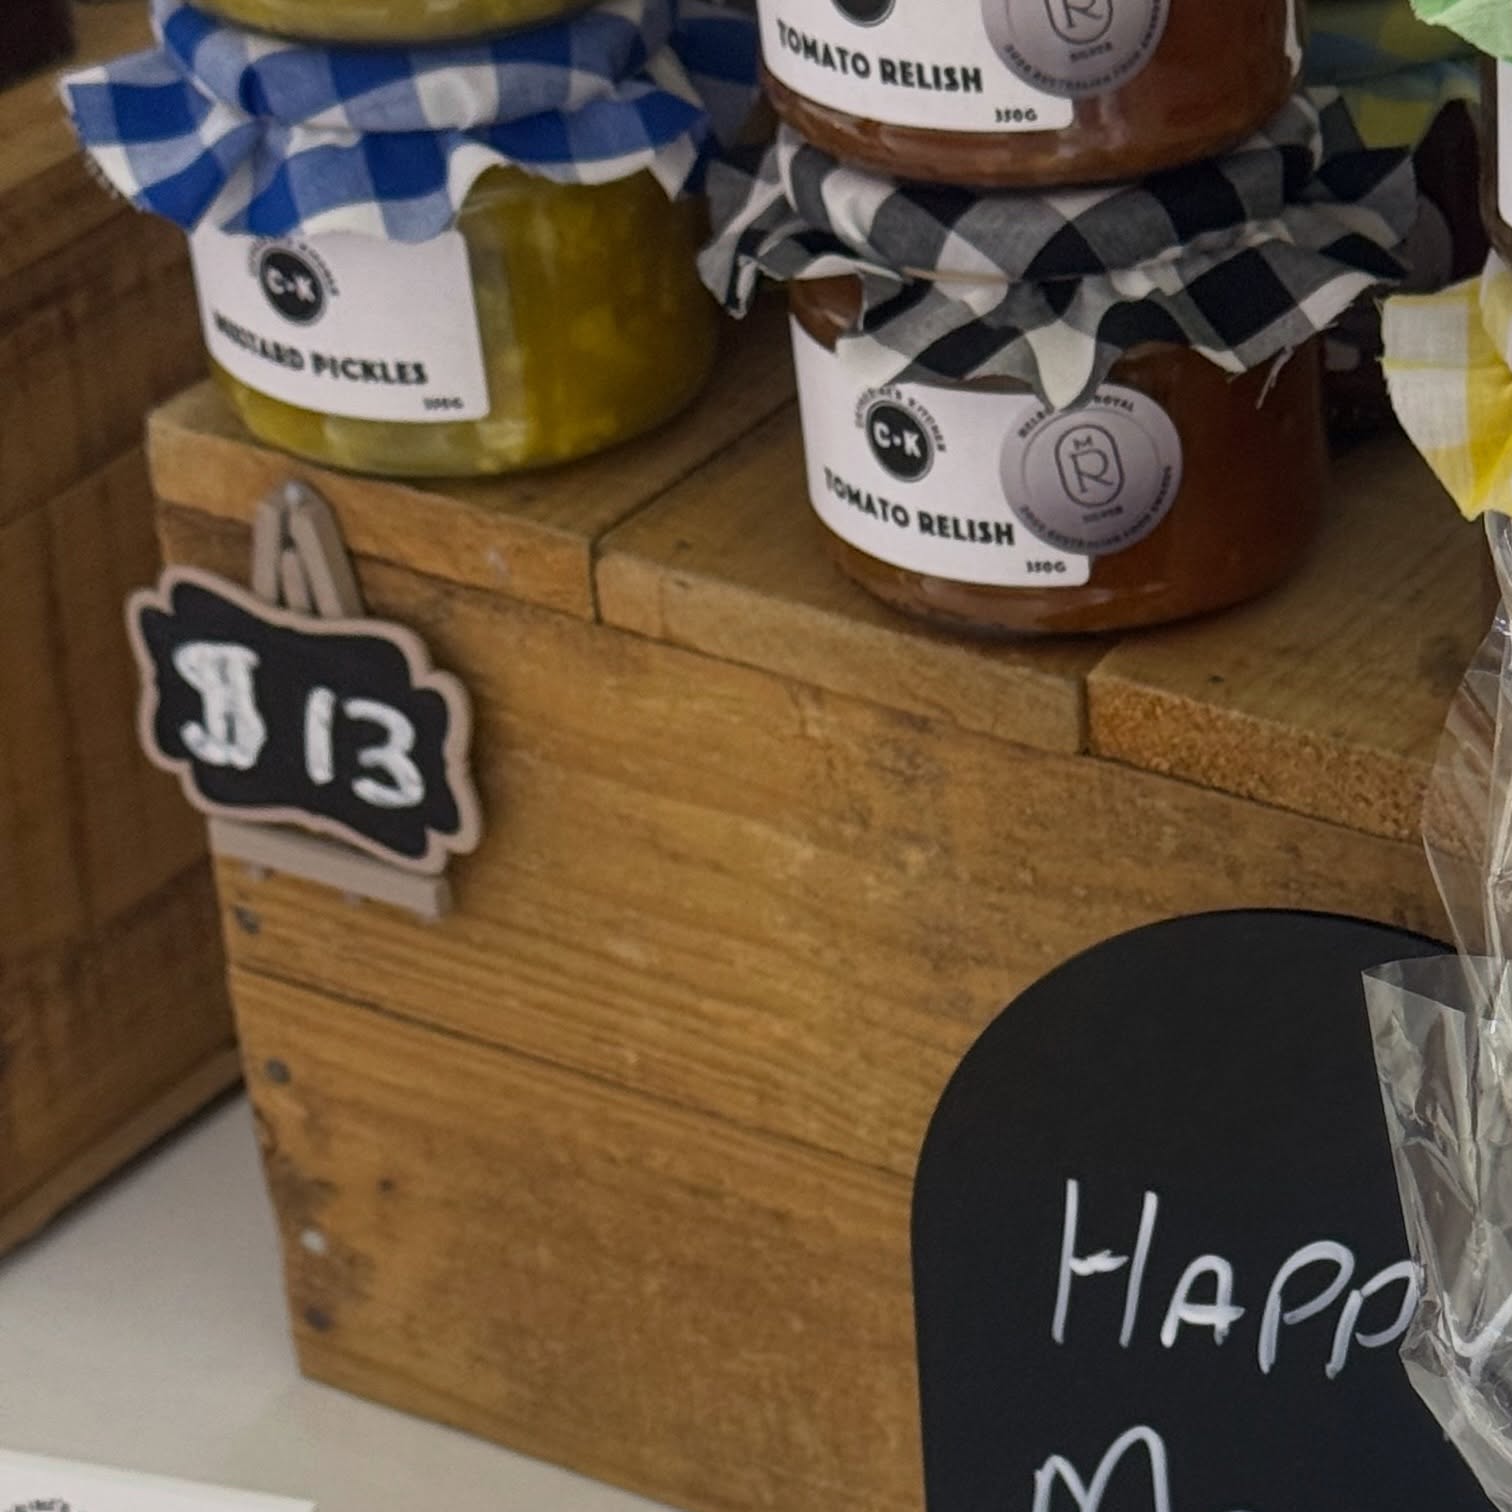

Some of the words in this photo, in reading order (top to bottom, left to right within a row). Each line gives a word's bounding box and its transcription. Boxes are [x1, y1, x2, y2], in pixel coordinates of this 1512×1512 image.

[777, 18, 871, 80] TOMATO
[879, 57, 984, 94] RELISH
[310, 350, 429, 385] PICKLES
[824, 466, 910, 528] TOMATO
[917, 511, 1016, 546] RELISH
